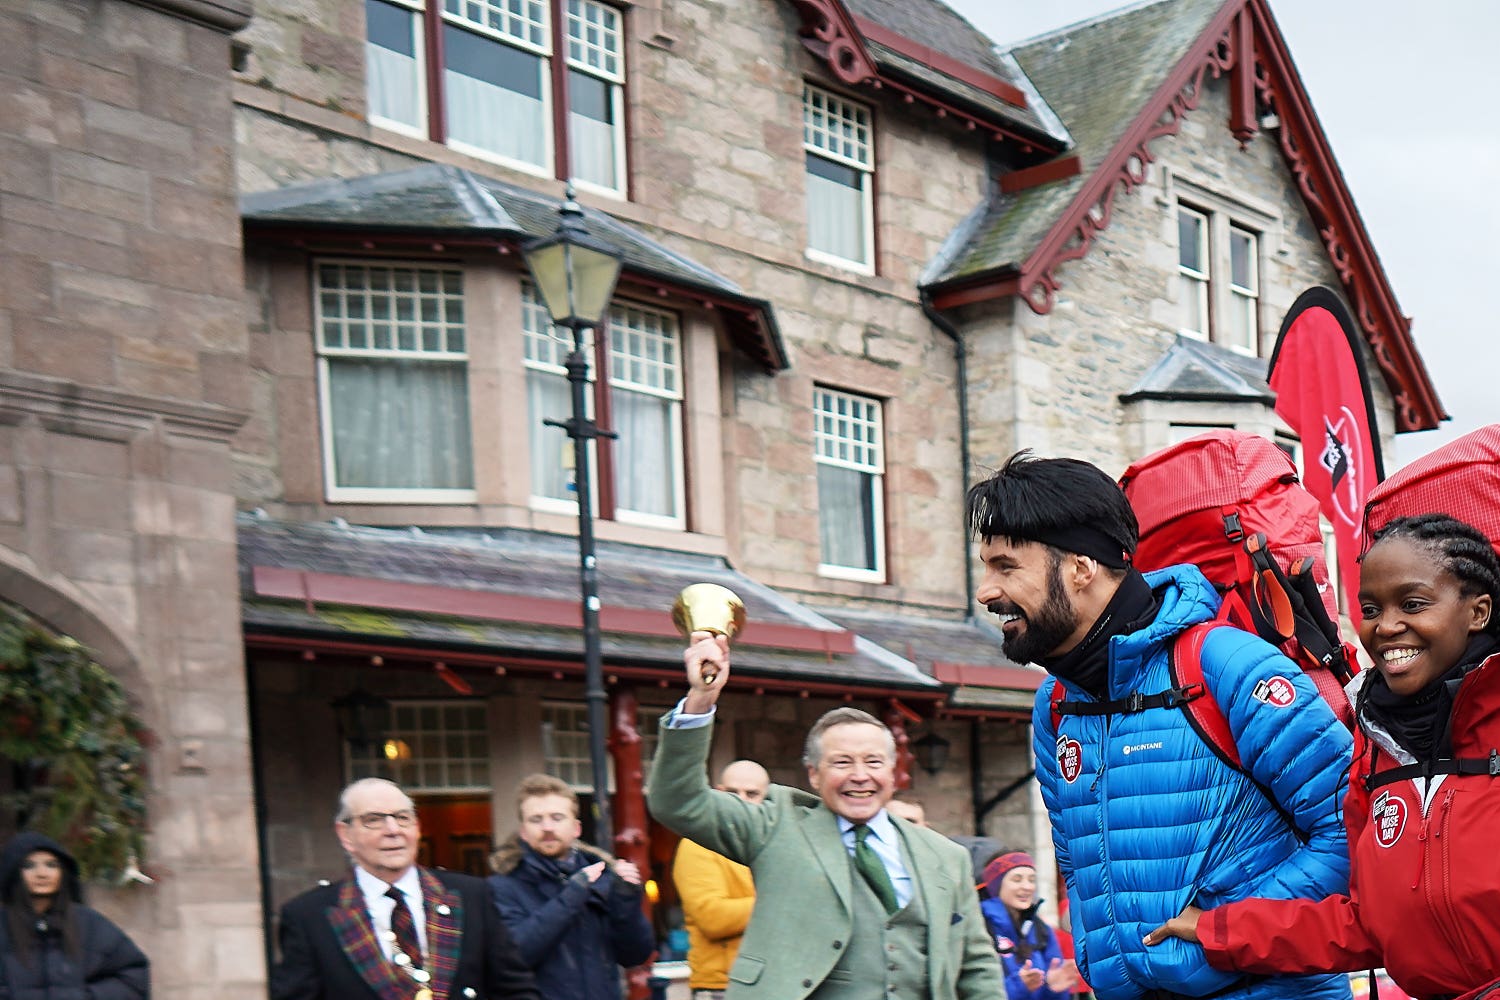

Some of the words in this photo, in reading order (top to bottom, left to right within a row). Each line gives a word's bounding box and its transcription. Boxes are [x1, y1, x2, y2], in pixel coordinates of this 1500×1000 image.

[1130, 741, 1162, 752] MONTANE
[1384, 804, 1398, 818] RED
[1381, 815, 1400, 830] NOSE
[1382, 827, 1396, 840] DAY
